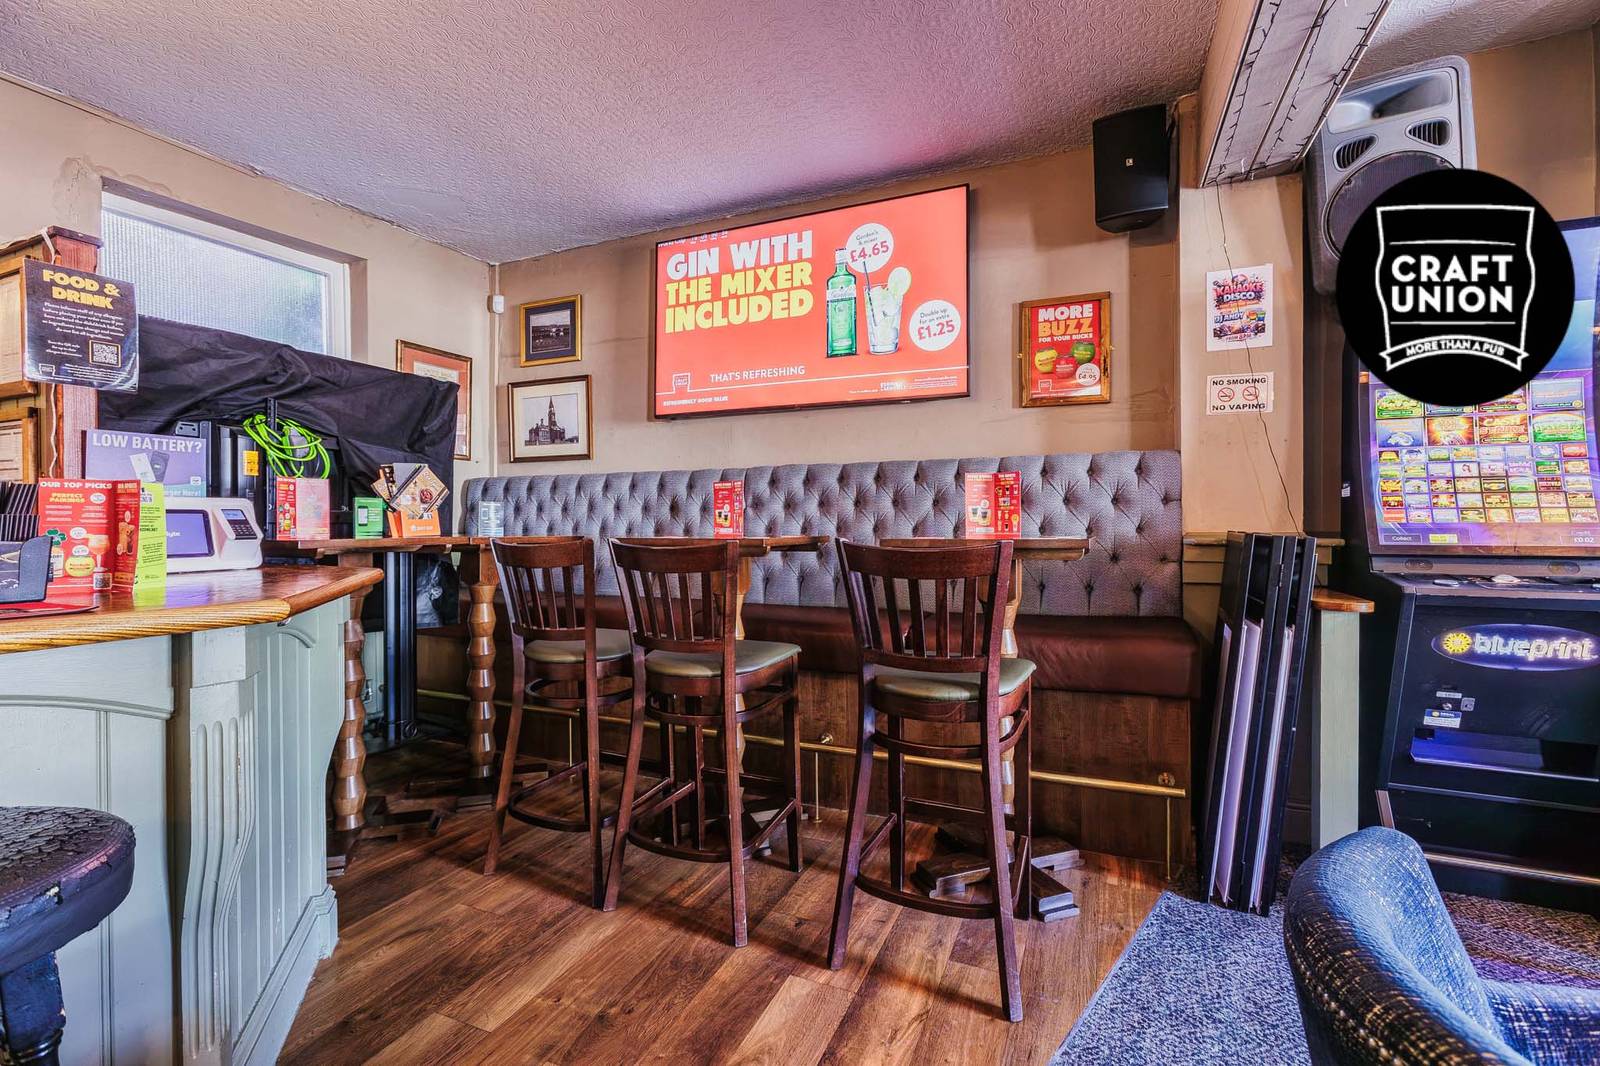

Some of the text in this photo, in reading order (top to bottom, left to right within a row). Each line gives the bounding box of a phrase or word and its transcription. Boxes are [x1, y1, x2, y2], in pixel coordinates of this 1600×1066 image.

[667, 230, 813, 280] GIN WITH
[850, 241, 889, 263] £4.65
[42, 269, 121, 297] FOOD &
[665, 261, 813, 306] THE MIXER
[1216, 282, 1265, 296] KARAOKE
[52, 286, 114, 310] DRINK
[1223, 291, 1255, 302] DISCO
[665, 289, 814, 334] INCLUDED
[1038, 303, 1093, 322] MORE
[1224, 311, 1244, 321] ANDY
[917, 319, 956, 340] £1.25
[1038, 317, 1093, 338] BUZZ
[710, 365, 806, 383] THAT'S REFRESHING
[1229, 403, 1266, 411] VAPING
[92, 433, 202, 453] LOW BATTERY?
[1474, 632, 1593, 661] blueprint
